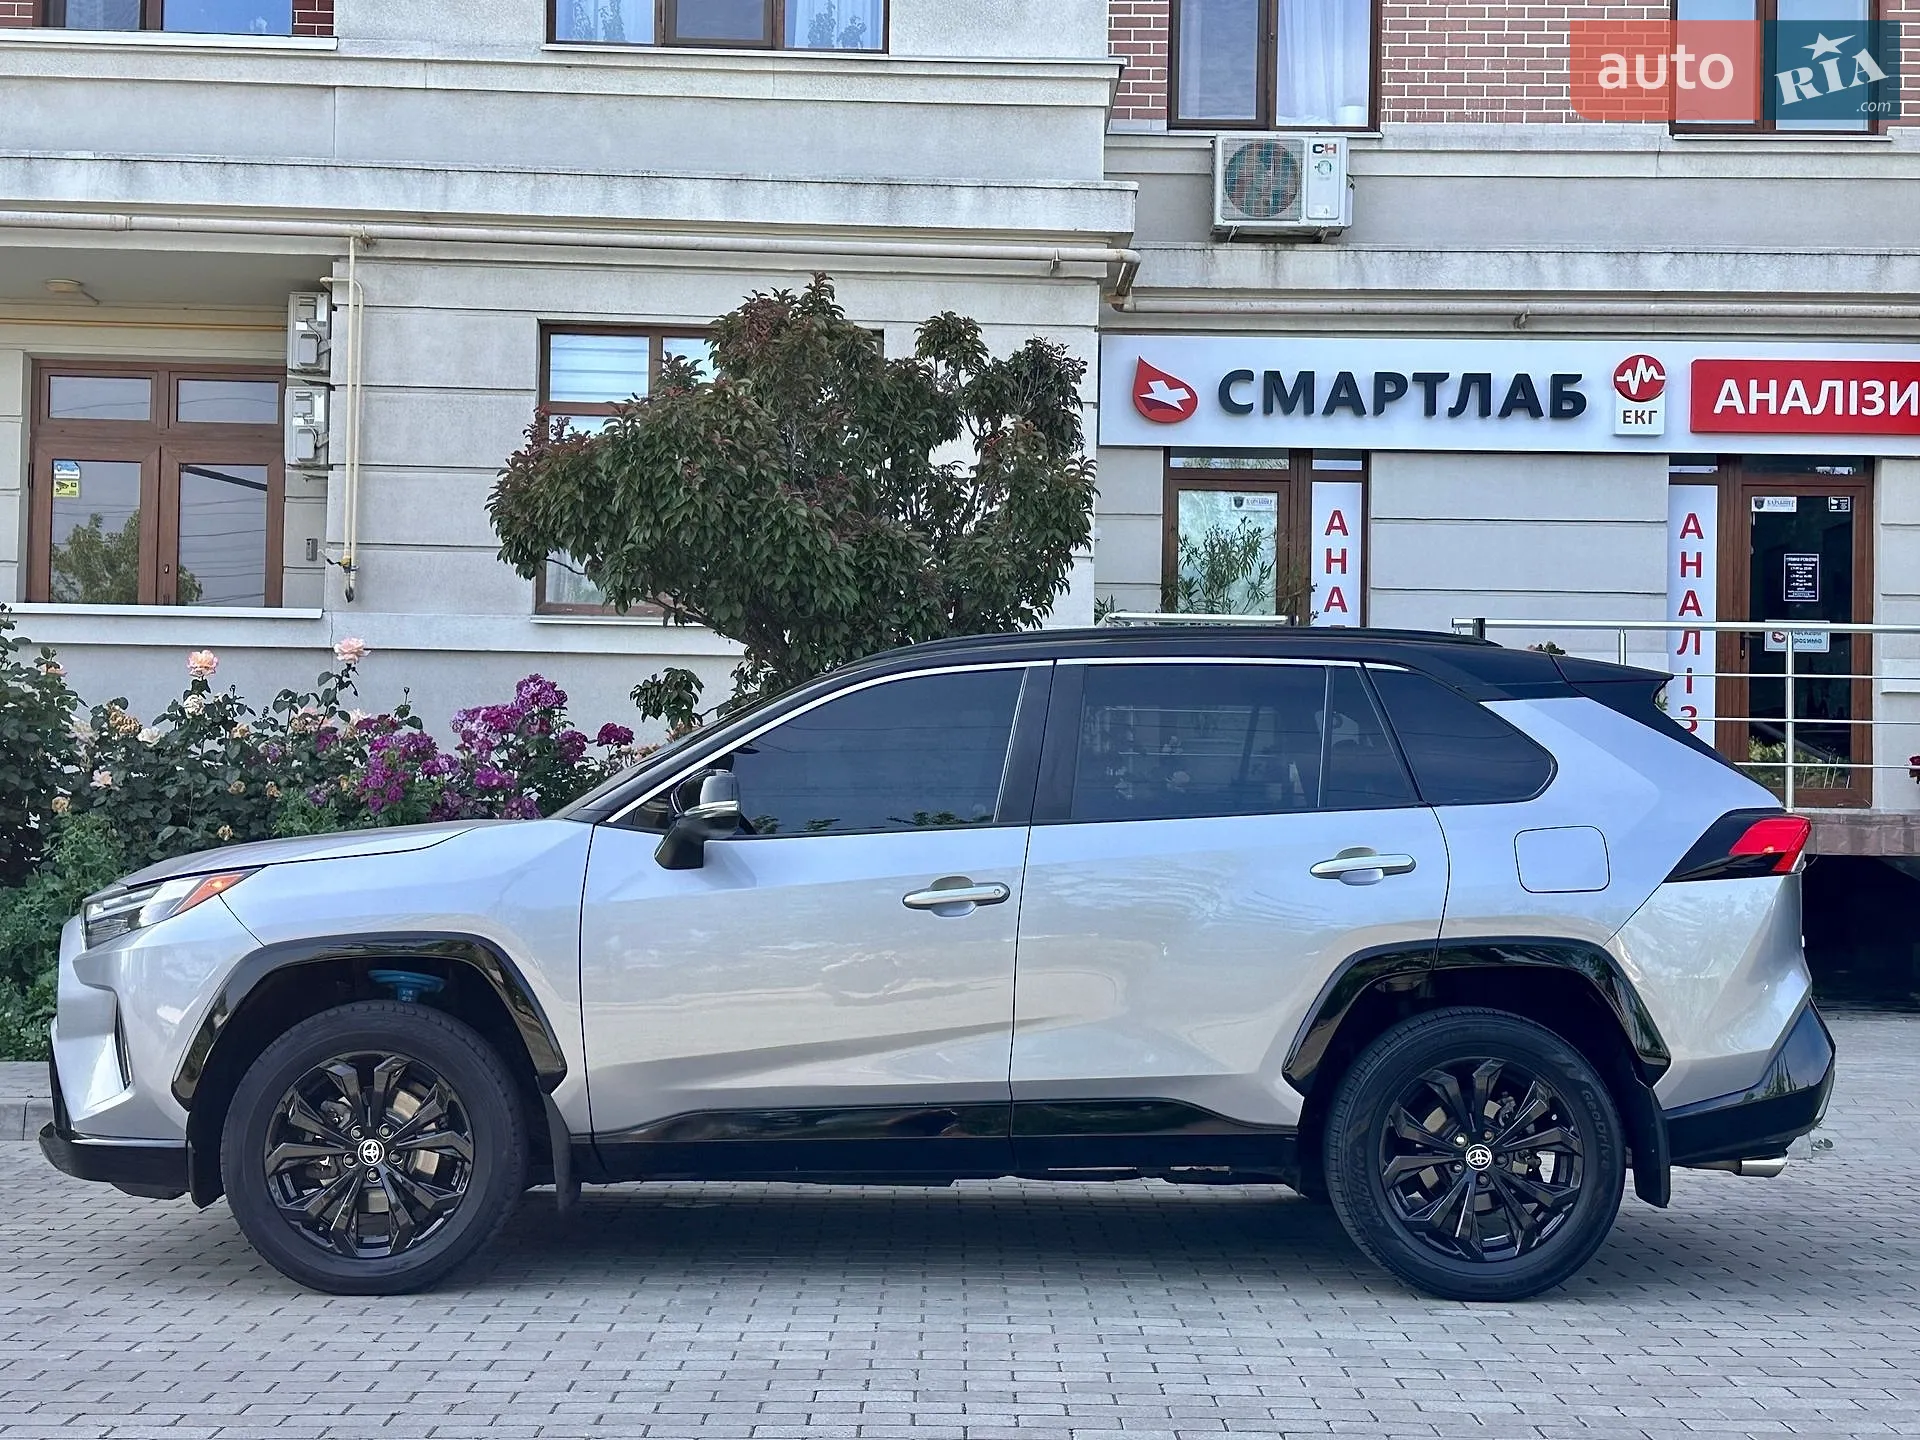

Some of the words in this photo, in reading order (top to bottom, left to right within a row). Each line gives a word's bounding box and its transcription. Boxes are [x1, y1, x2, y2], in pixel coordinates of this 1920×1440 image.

[1312, 143, 1337, 154] CH
[1217, 368, 1588, 421] СМАРТЛАБ
[1713, 378, 1919, 417] АНАЛІЗИ
[1622, 409, 1658, 425] ЕКГ
[1323, 509, 1349, 627] АНА
